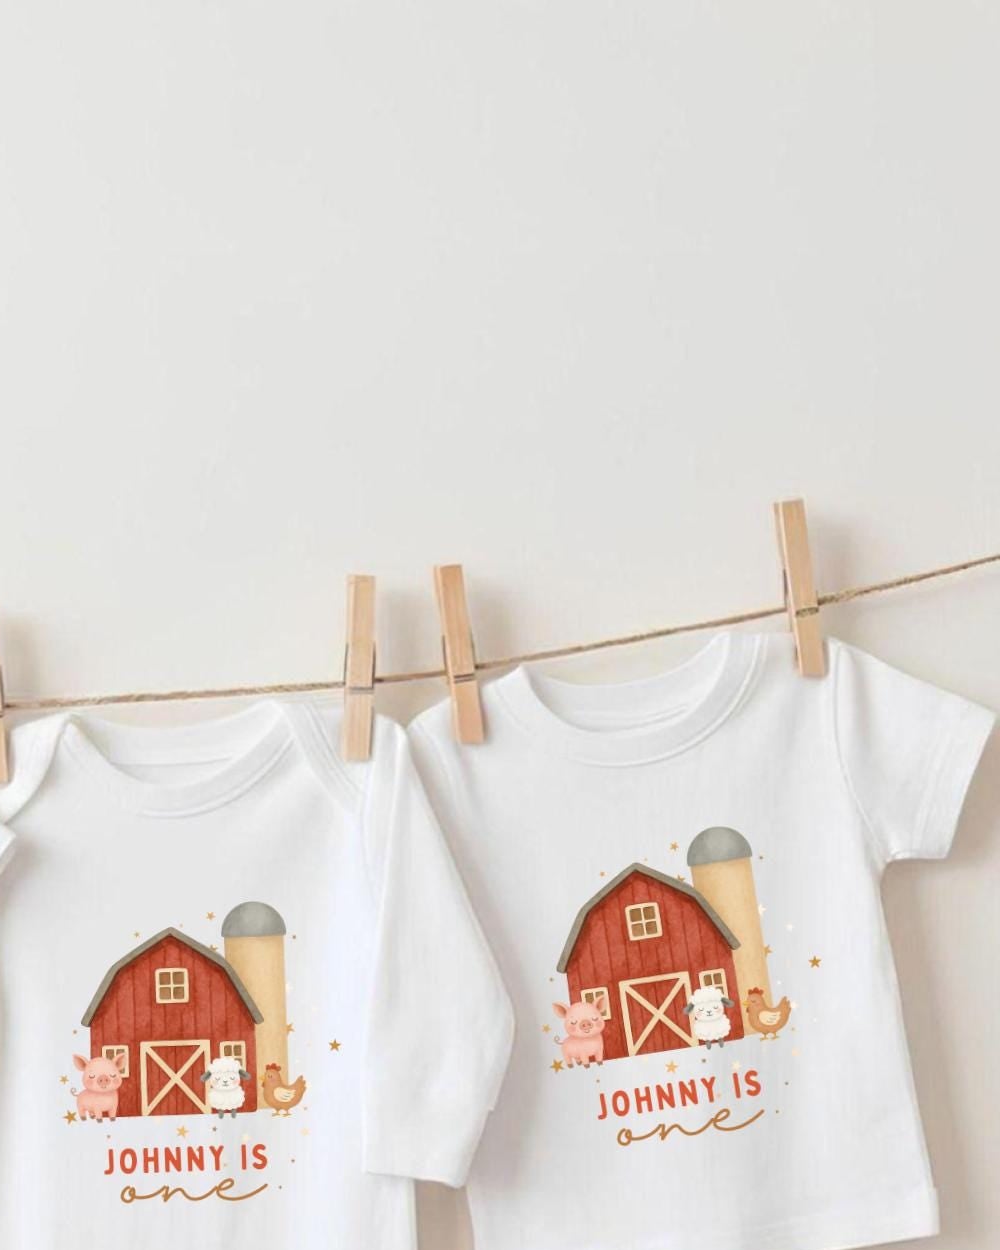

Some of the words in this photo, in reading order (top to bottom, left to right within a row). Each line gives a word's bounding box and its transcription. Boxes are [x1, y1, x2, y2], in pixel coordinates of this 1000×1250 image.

[597, 1075, 717, 1120] JOHNNY
[732, 1068, 761, 1099] IS
[617, 1108, 765, 1146] one
[104, 1145, 225, 1176] JOHNNY
[241, 1142, 268, 1171] IS
[121, 1178, 269, 1204] one
